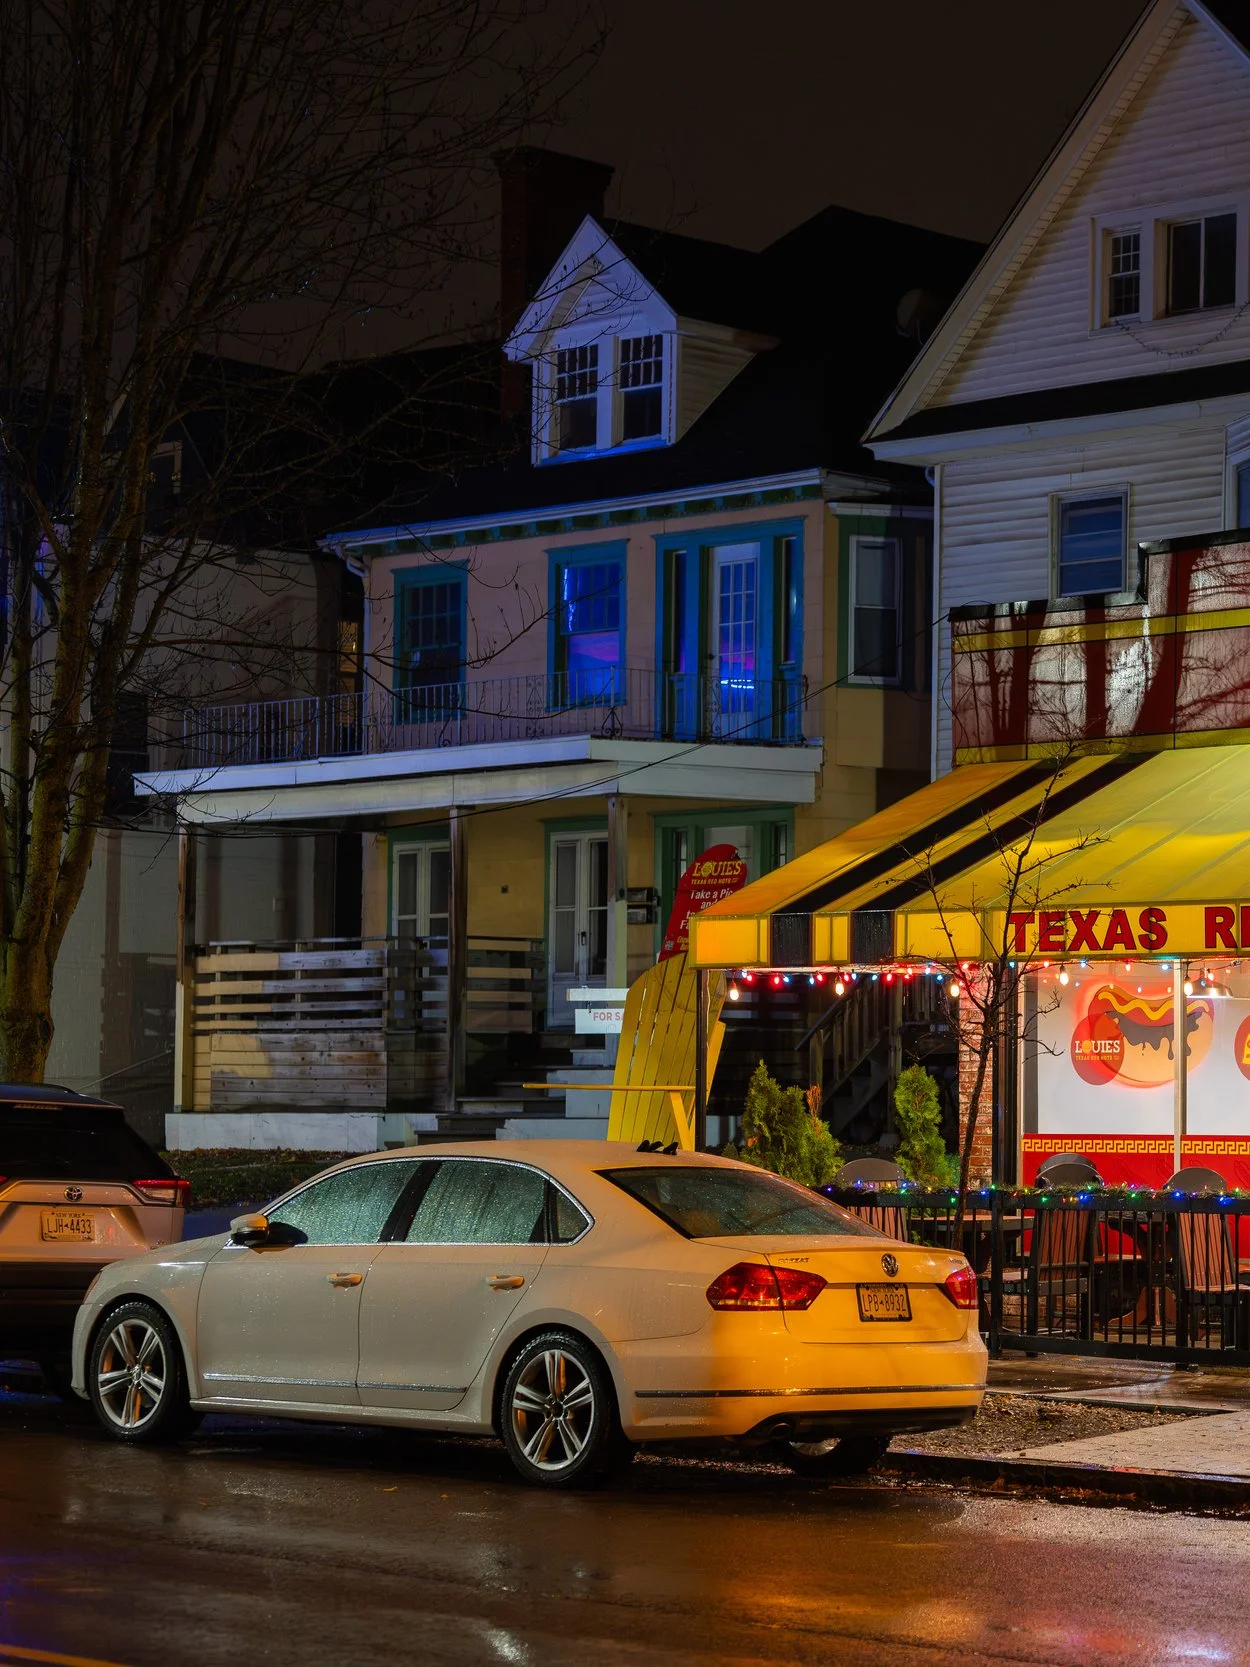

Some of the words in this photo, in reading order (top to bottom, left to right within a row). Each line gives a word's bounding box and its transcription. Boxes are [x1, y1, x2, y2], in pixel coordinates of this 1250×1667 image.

[690, 889, 711, 900] Take
[712, 891, 718, 899] a
[1008, 907, 1169, 953] TEXAS
[593, 1011, 613, 1021] FOR
